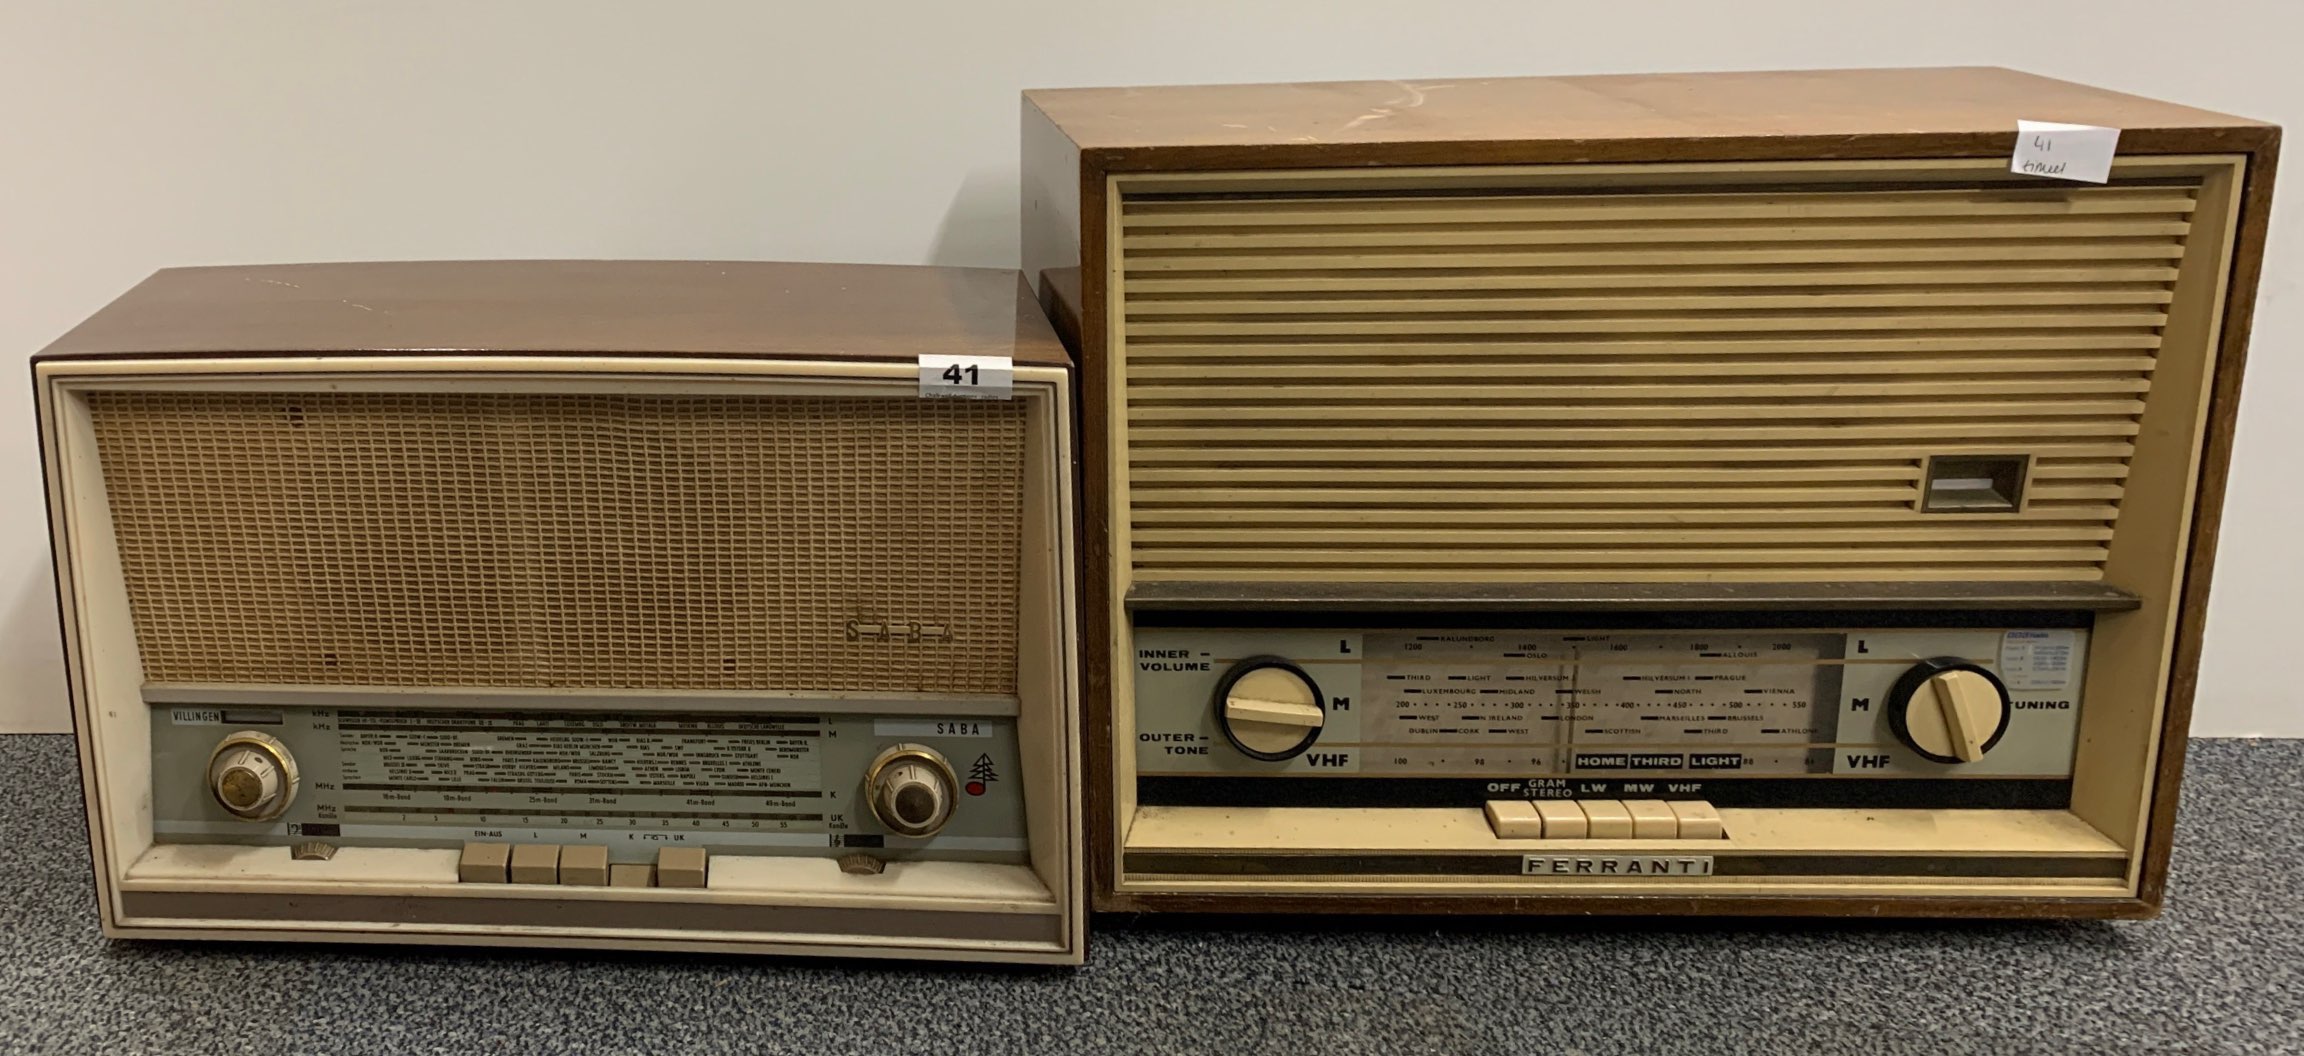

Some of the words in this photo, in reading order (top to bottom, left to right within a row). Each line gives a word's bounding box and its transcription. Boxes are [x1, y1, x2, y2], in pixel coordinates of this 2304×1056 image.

[2034, 135, 2051, 151] 41
[943, 364, 979, 386] 41
[846, 618, 953, 643] SABA
[1340, 640, 1351, 653] L
[1858, 640, 1869, 654] L
[1139, 650, 1189, 659] INNER
[1140, 662, 1211, 671] VOLUME
[1333, 697, 1349, 710] M
[1792, 701, 1807, 709] 550
[1851, 698, 1870, 711] M
[2009, 701, 2070, 709] UNING
[173, 711, 220, 722] VILLINGEN
[313, 723, 331, 731] kHz
[936, 722, 980, 735] SABA
[828, 730, 837, 738] M
[1139, 733, 1195, 742] OUTER
[1164, 746, 1209, 755] TONE
[1306, 754, 1349, 767] VHF
[1393, 757, 1408, 765] 100
[1577, 757, 1626, 766] HOME
[1632, 757, 1682, 766] THIRD
[1691, 757, 1740, 766] LIGHT
[1847, 755, 1890, 768] VHF
[315, 783, 335, 791] MHz
[1487, 783, 1521, 793] OFF
[1528, 779, 1566, 788] GRAM
[1523, 788, 1573, 798] STEREO
[1580, 784, 1607, 793] LW
[1624, 784, 1655, 793] MW
[1668, 784, 1702, 793] VHF
[830, 791, 837, 799] K
[316, 804, 337, 812] MHz
[830, 814, 844, 822] UK
[560, 817, 568, 825] 20
[721, 820, 730, 828] 45
[780, 821, 788, 829] 55
[474, 830, 503, 838] EIN-AUS
[1527, 858, 1710, 873] FERRANTI
